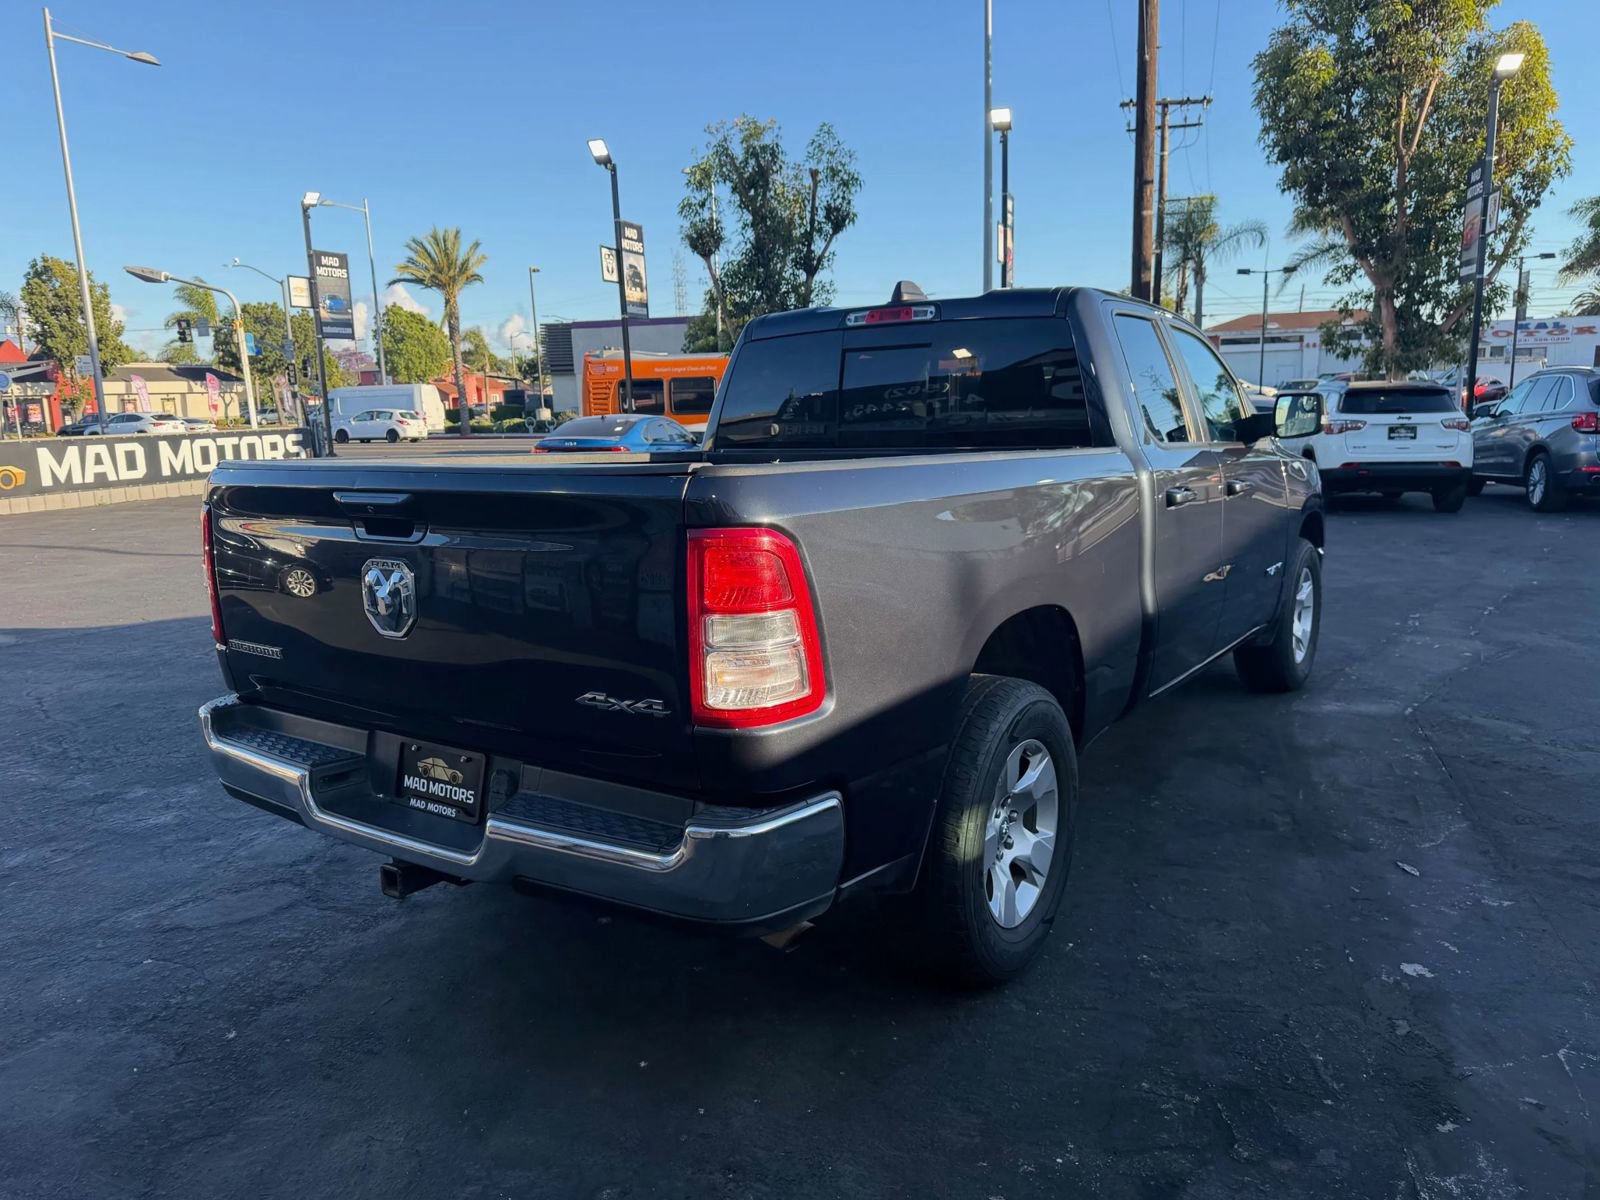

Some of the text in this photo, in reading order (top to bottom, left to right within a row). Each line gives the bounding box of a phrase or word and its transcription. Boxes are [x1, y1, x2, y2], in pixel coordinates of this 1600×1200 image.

[321, 255, 340, 267] MAD
[316, 266, 348, 279] MOTORS
[36, 433, 307, 487] MAD MOTORS
[369, 560, 401, 569] RAM
[403, 774, 475, 804] MAD MOTORS
[409, 798, 457, 818] MAD MOTORS
